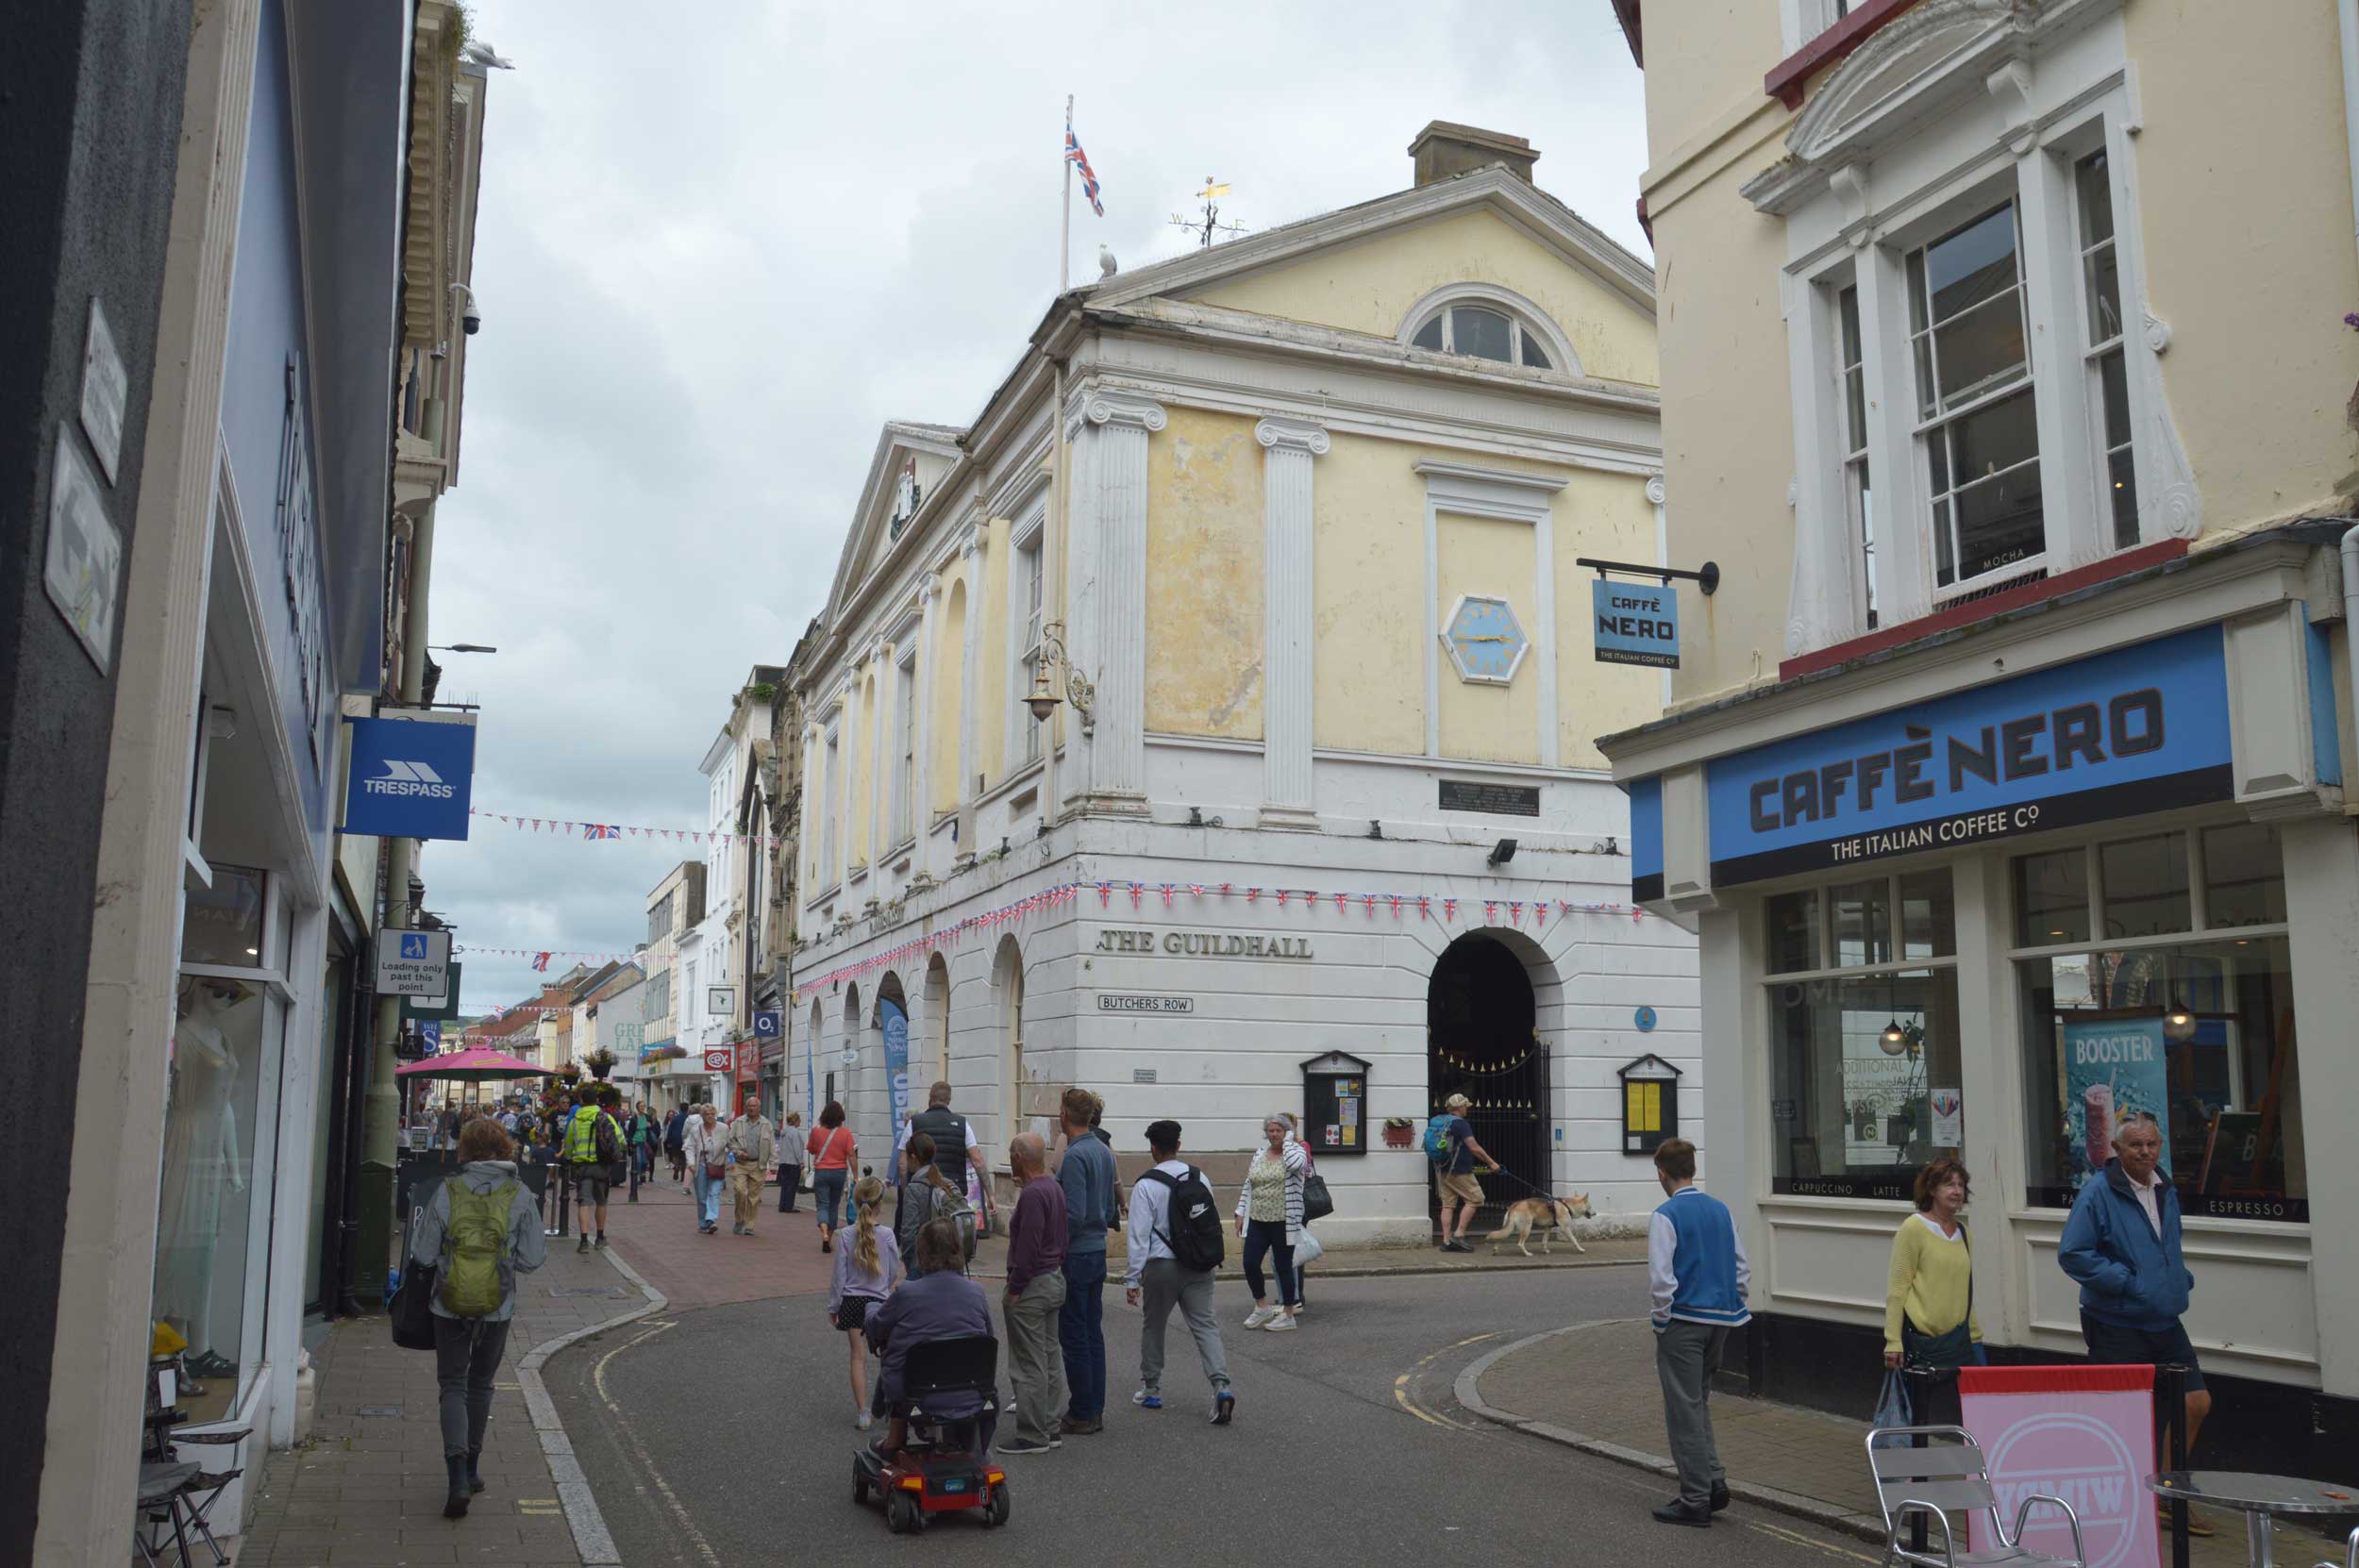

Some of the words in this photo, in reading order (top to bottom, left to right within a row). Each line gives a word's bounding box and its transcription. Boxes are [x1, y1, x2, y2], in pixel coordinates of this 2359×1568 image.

[1983, 547, 2025, 570] MOCHA
[1611, 595, 1661, 612] CAFFÈ
[1598, 615, 1674, 641] NERO
[1600, 651, 1613, 659] THE
[1614, 652, 1639, 662] ITALIAN
[1641, 655, 1665, 665] COFFEE
[1749, 723, 1934, 834] CAFFÈ
[1948, 687, 2166, 793] NERO
[363, 779, 454, 799] TRESPASS
[1832, 839, 1862, 861] THE
[1865, 825, 1934, 857] ITALIAN
[1939, 809, 2007, 842] COFFEE
[1102, 930, 1155, 952] THE
[1163, 932, 1313, 959] GUILDHALL
[382, 962, 420, 974] Loading
[423, 964, 443, 974] only
[391, 974, 411, 982] past
[398, 982, 424, 992] point
[1102, 996, 1159, 1010] BUTCHERS
[1164, 998, 1188, 1010] ROW
[2075, 1035, 2155, 1065] BOOSTER
[1792, 1182, 1853, 1195] CAPPUCCINO
[1873, 1185, 1901, 1197] LATTE
[2209, 1200, 2284, 1216] ESPRESSO
